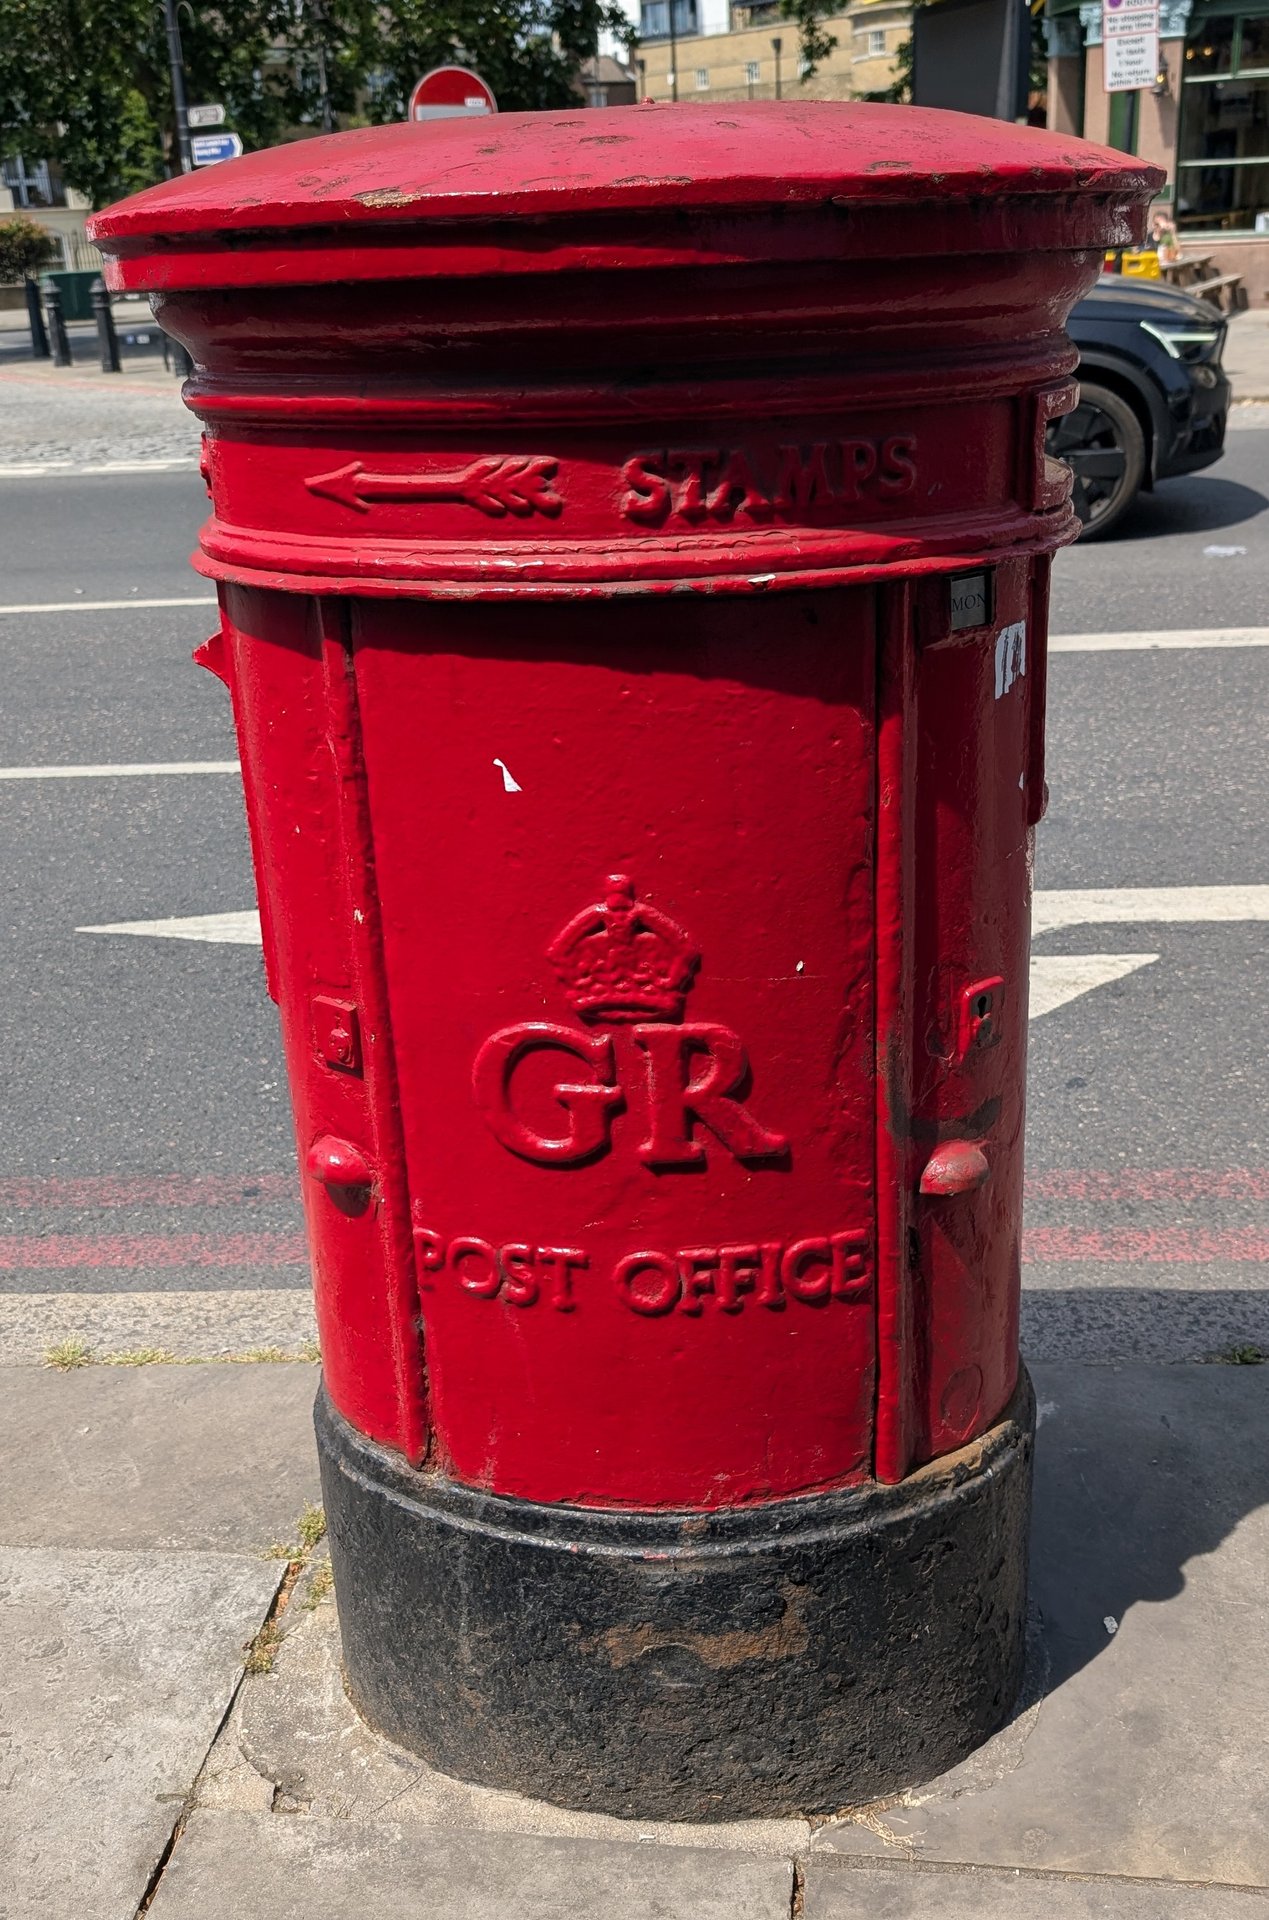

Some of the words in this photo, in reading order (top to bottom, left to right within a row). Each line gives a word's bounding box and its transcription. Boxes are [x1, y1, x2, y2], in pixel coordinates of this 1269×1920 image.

[620, 435, 918, 525] STAMPS
[472, 1021, 791, 1170] GR
[413, 1227, 590, 1311] POST
[614, 1229, 872, 1315] OFFICE
